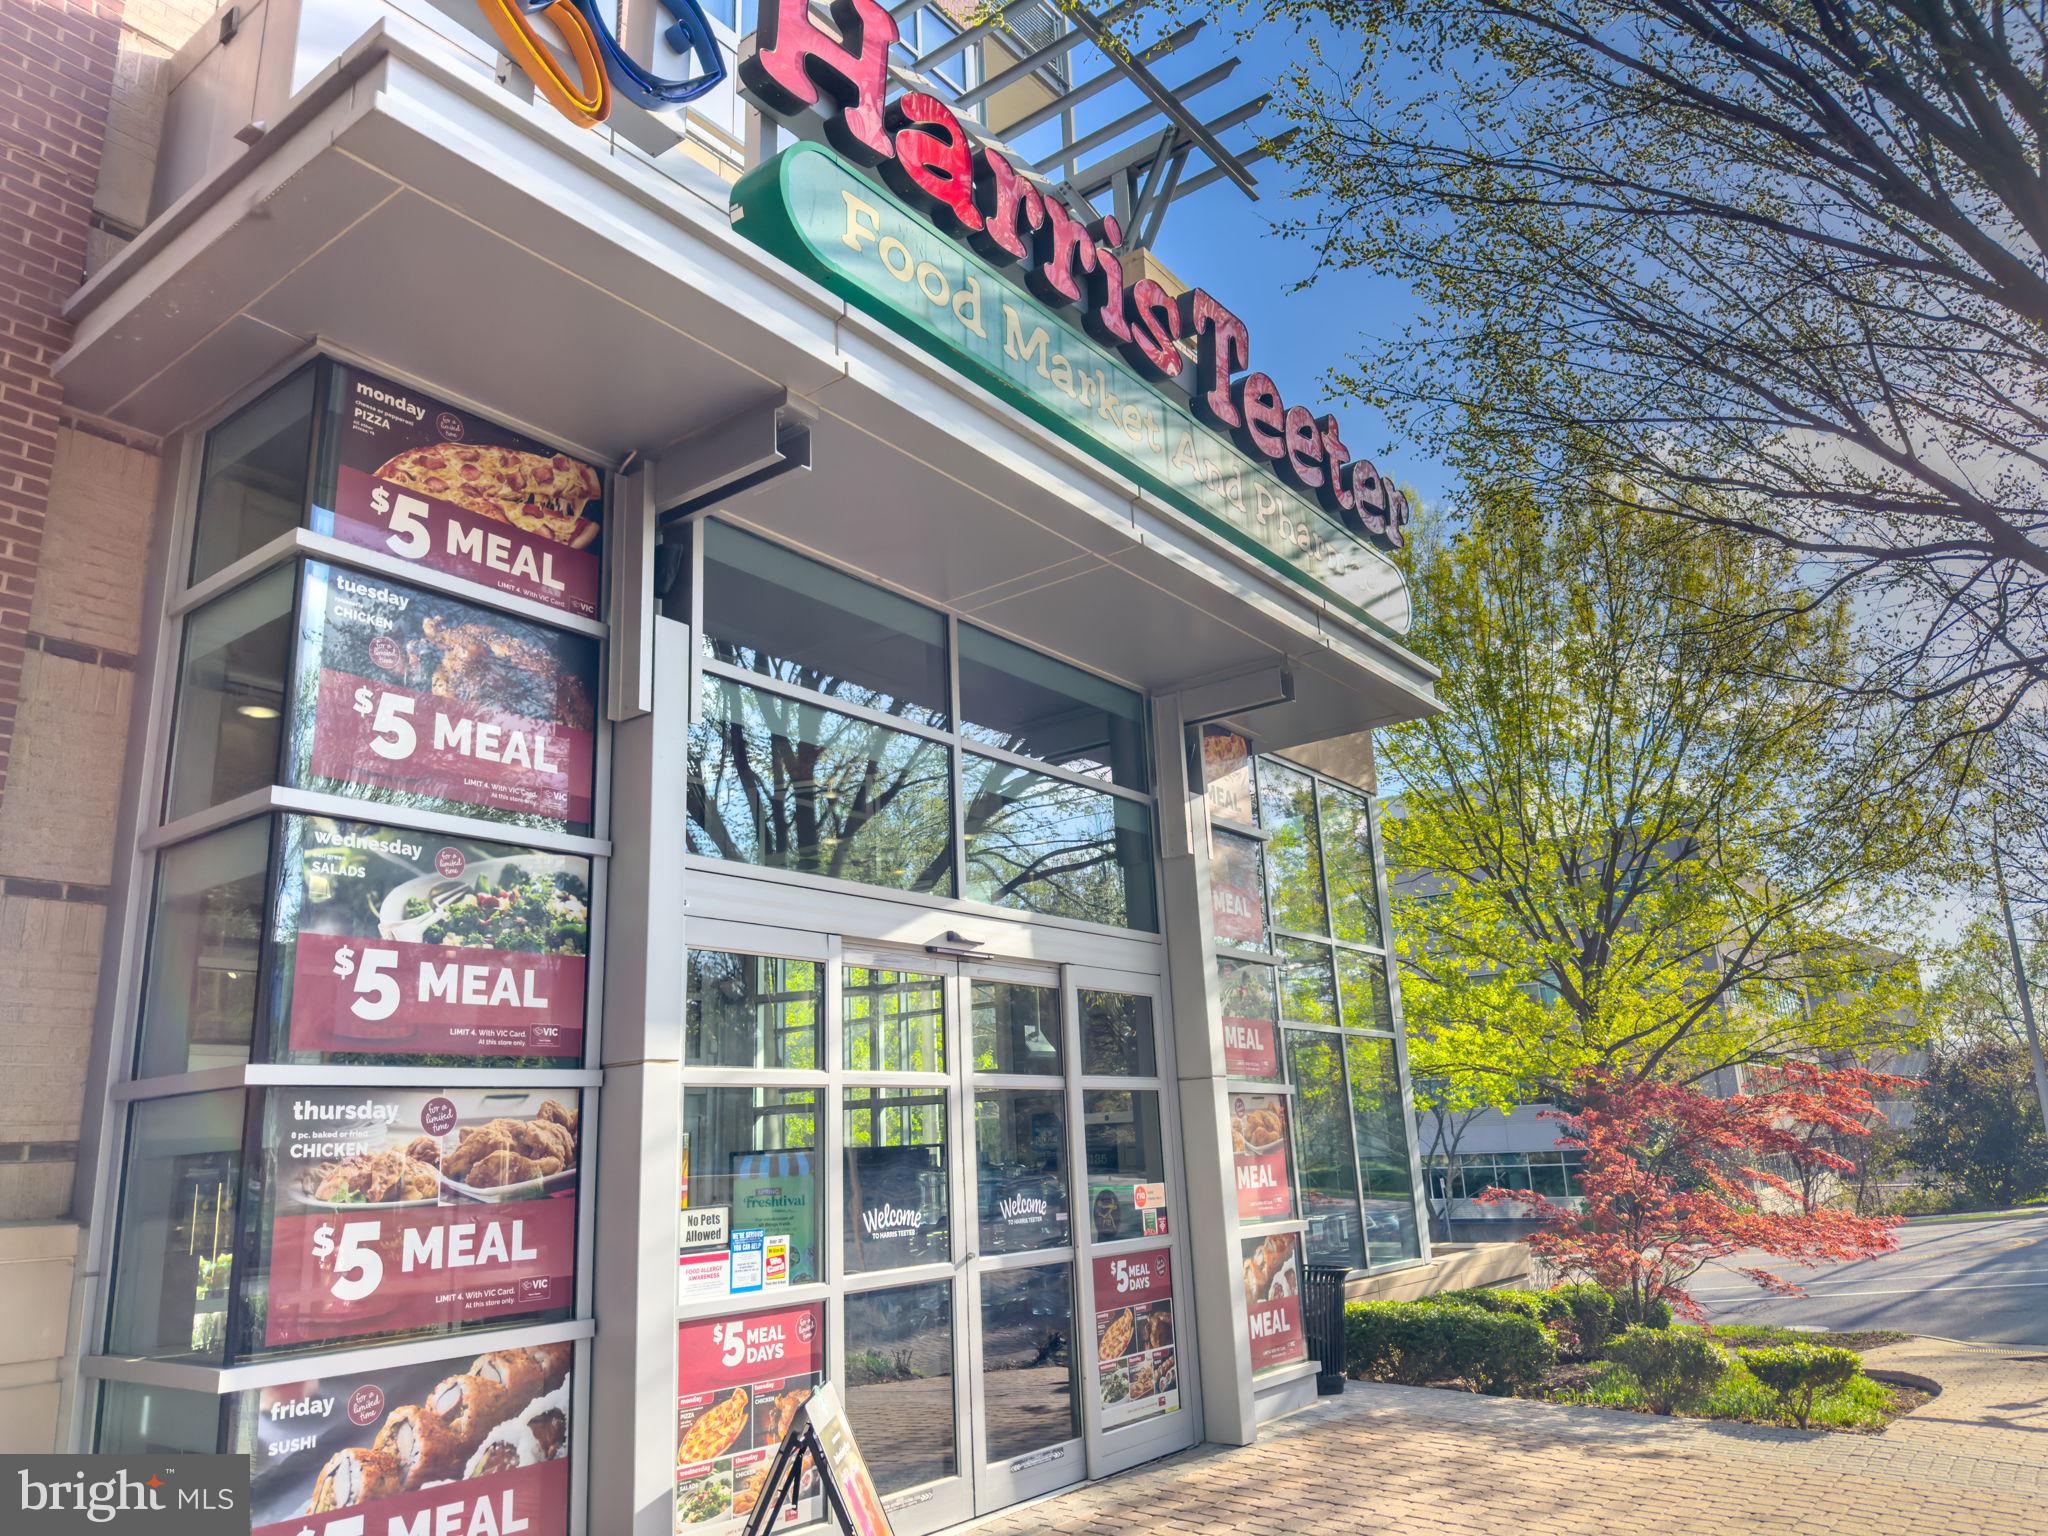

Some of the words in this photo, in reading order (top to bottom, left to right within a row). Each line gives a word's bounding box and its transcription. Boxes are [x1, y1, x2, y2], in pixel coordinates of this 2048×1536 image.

[758, 0, 1183, 378] Harris
[1194, 287, 1409, 548] Teeter
[840, 190, 987, 338] Food
[1003, 307, 1162, 454] Market
[1172, 434, 1247, 516] And
[356, 382, 426, 420] monday
[354, 407, 391, 430] PIZZA
[440, 421, 461, 432] limited
[370, 485, 431, 560] $5
[446, 519, 565, 591] MEAL
[336, 575, 410, 611] tuesday
[497, 580, 515, 592] LIMIT
[523, 588, 538, 598] With
[539, 594, 550, 603] VIC
[579, 602, 594, 613] VIC
[334, 605, 393, 630] CHICKEN
[352, 685, 417, 760] $5
[433, 712, 559, 774] MEAL
[464, 778, 483, 788] LIMIT
[491, 783, 507, 792] With
[508, 787, 520, 795] VIC
[498, 793, 509, 801] this
[553, 791, 567, 801] VIC
[1208, 785, 1242, 812] MEAL
[314, 831, 423, 861] wednesday
[439, 859, 463, 868] limited
[441, 851, 452, 860] for
[312, 861, 366, 878] SALADS
[444, 867, 459, 875] time
[1213, 890, 1252, 918] MEAL
[333, 945, 401, 1021] $5
[418, 961, 549, 1009] MEAL
[449, 1028, 470, 1036] LIMIT
[478, 1029, 495, 1037] With
[543, 1027, 559, 1037] VIC
[1224, 1025, 1264, 1051] MEAL
[293, 1100, 400, 1125] thursday
[425, 1108, 454, 1124] limited
[428, 1102, 440, 1115] for
[298, 1133, 311, 1141] pc.
[312, 1130, 338, 1139] baked
[349, 1129, 369, 1138] fried
[432, 1124, 450, 1133] time
[290, 1142, 369, 1159] CHICKEN
[1237, 1164, 1278, 1190] MEAL
[1000, 1193, 1047, 1220] Welcome
[687, 1215, 699, 1227] No
[700, 1213, 721, 1226] Pets
[862, 1203, 922, 1233] Welcome
[685, 1227, 722, 1243] Allowed
[872, 1232, 880, 1240] TO
[880, 1230, 898, 1239] HARRIS
[898, 1229, 916, 1237] TEETER
[312, 1221, 384, 1301] $5
[402, 1219, 537, 1272] MEAL
[686, 1267, 700, 1275] FOOD
[701, 1265, 723, 1273] ALLERGY
[688, 1272, 720, 1281] AWARENESS
[1110, 1260, 1129, 1293] $5
[1128, 1263, 1151, 1277] MEAL
[532, 1279, 548, 1289] VIC
[1129, 1277, 1151, 1291] DAYS
[435, 1294, 456, 1303] LIMIT
[465, 1291, 483, 1300] With
[497, 1287, 515, 1296] Card.
[465, 1301, 473, 1309] At
[473, 1300, 484, 1308] this
[485, 1299, 501, 1307] store
[1250, 1308, 1291, 1340] MEAL
[713, 1321, 745, 1367] $5
[746, 1324, 786, 1345] MEAL
[746, 1343, 785, 1364] DAYS
[353, 1395, 381, 1414] limited
[355, 1392, 367, 1404] for
[680, 1396, 702, 1405] monday
[754, 1396, 775, 1405] CHICKEN
[271, 1397, 336, 1422] friday
[359, 1408, 377, 1421] time
[268, 1435, 318, 1457] SUSHI
[735, 1469, 756, 1479] CHICKEN
